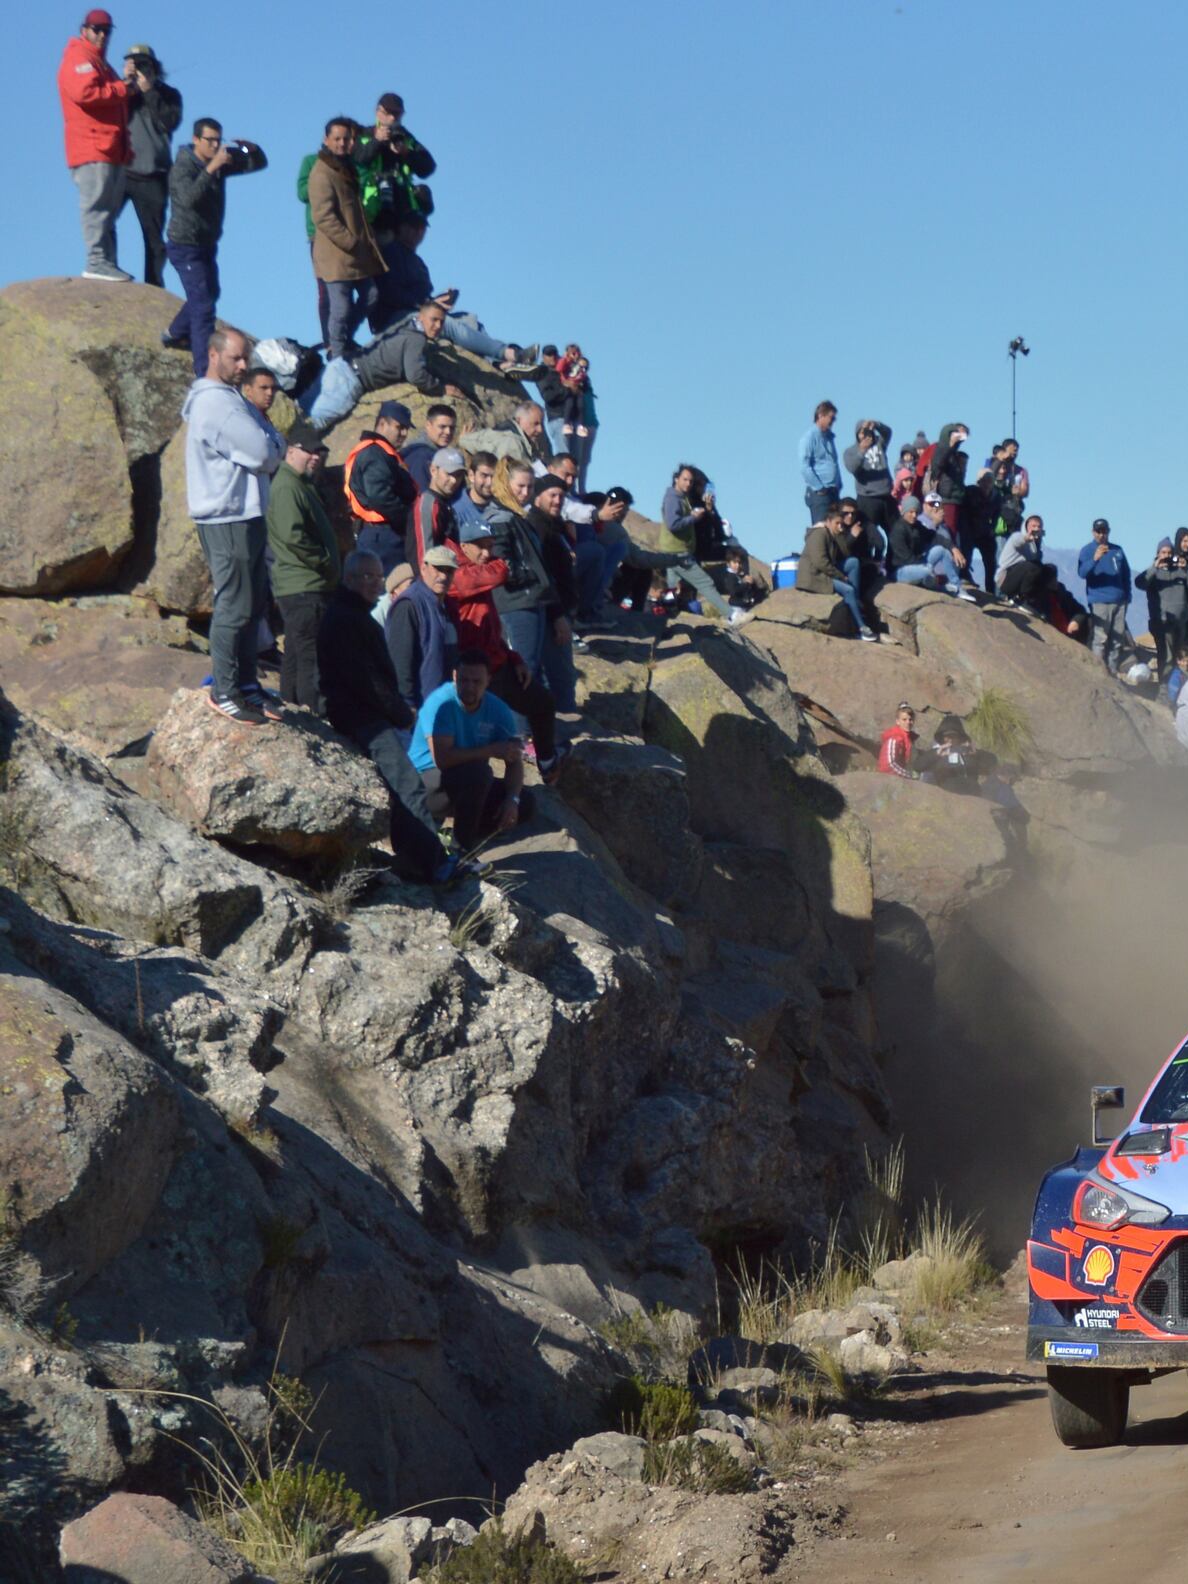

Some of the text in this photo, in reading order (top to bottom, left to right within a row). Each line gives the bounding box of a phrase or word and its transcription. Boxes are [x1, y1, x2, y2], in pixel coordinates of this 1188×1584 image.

[1086, 1309, 1119, 1318] HYUNDAI
[1089, 1319, 1112, 1327] STEEL
[1056, 1347, 1093, 1355] MICHELIN
